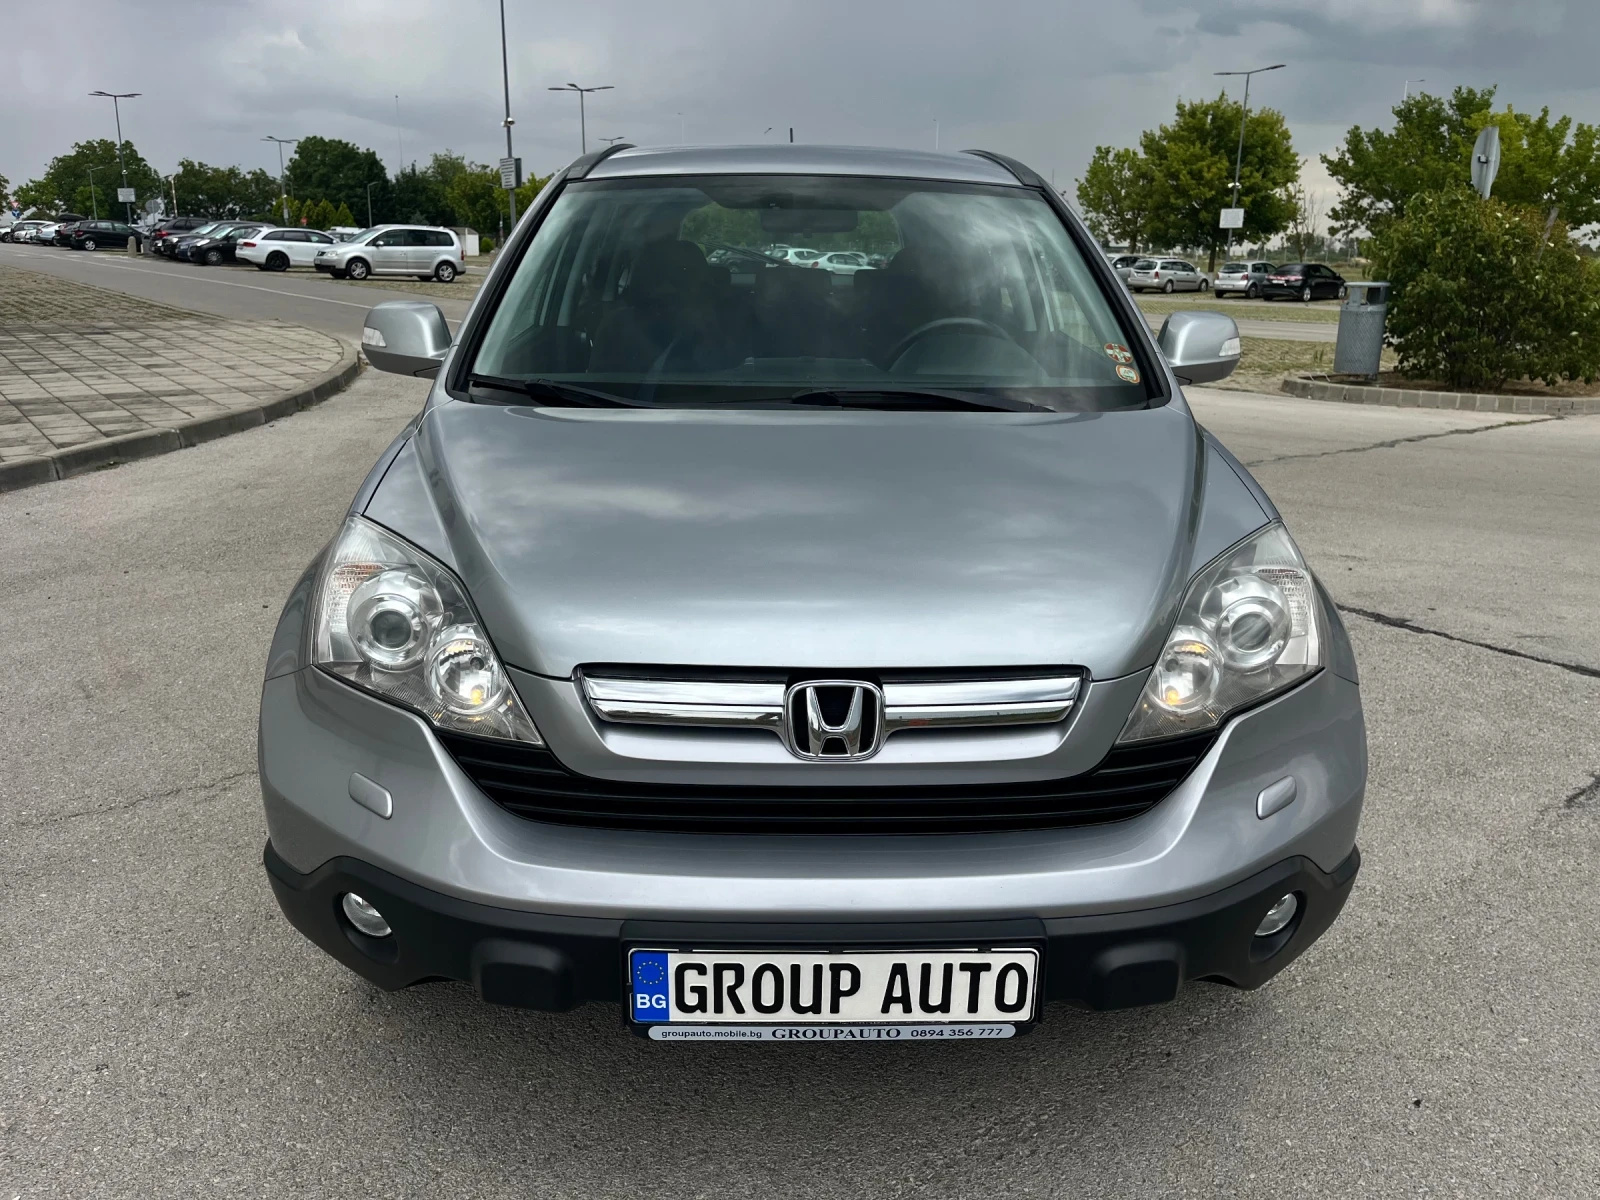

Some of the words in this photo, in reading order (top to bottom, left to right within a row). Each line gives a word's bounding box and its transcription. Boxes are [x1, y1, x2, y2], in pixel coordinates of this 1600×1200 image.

[674, 962, 861, 1015] GROUP
[880, 962, 1029, 1014] AUTO
[636, 993, 667, 1009] BG
[661, 1030, 762, 1039] groupauto.mobile.bg
[771, 1028, 902, 1039] GROUPAUTO
[910, 1029, 945, 1038] 0894
[948, 1028, 974, 1037] 356
[978, 1028, 1003, 1036] 777
